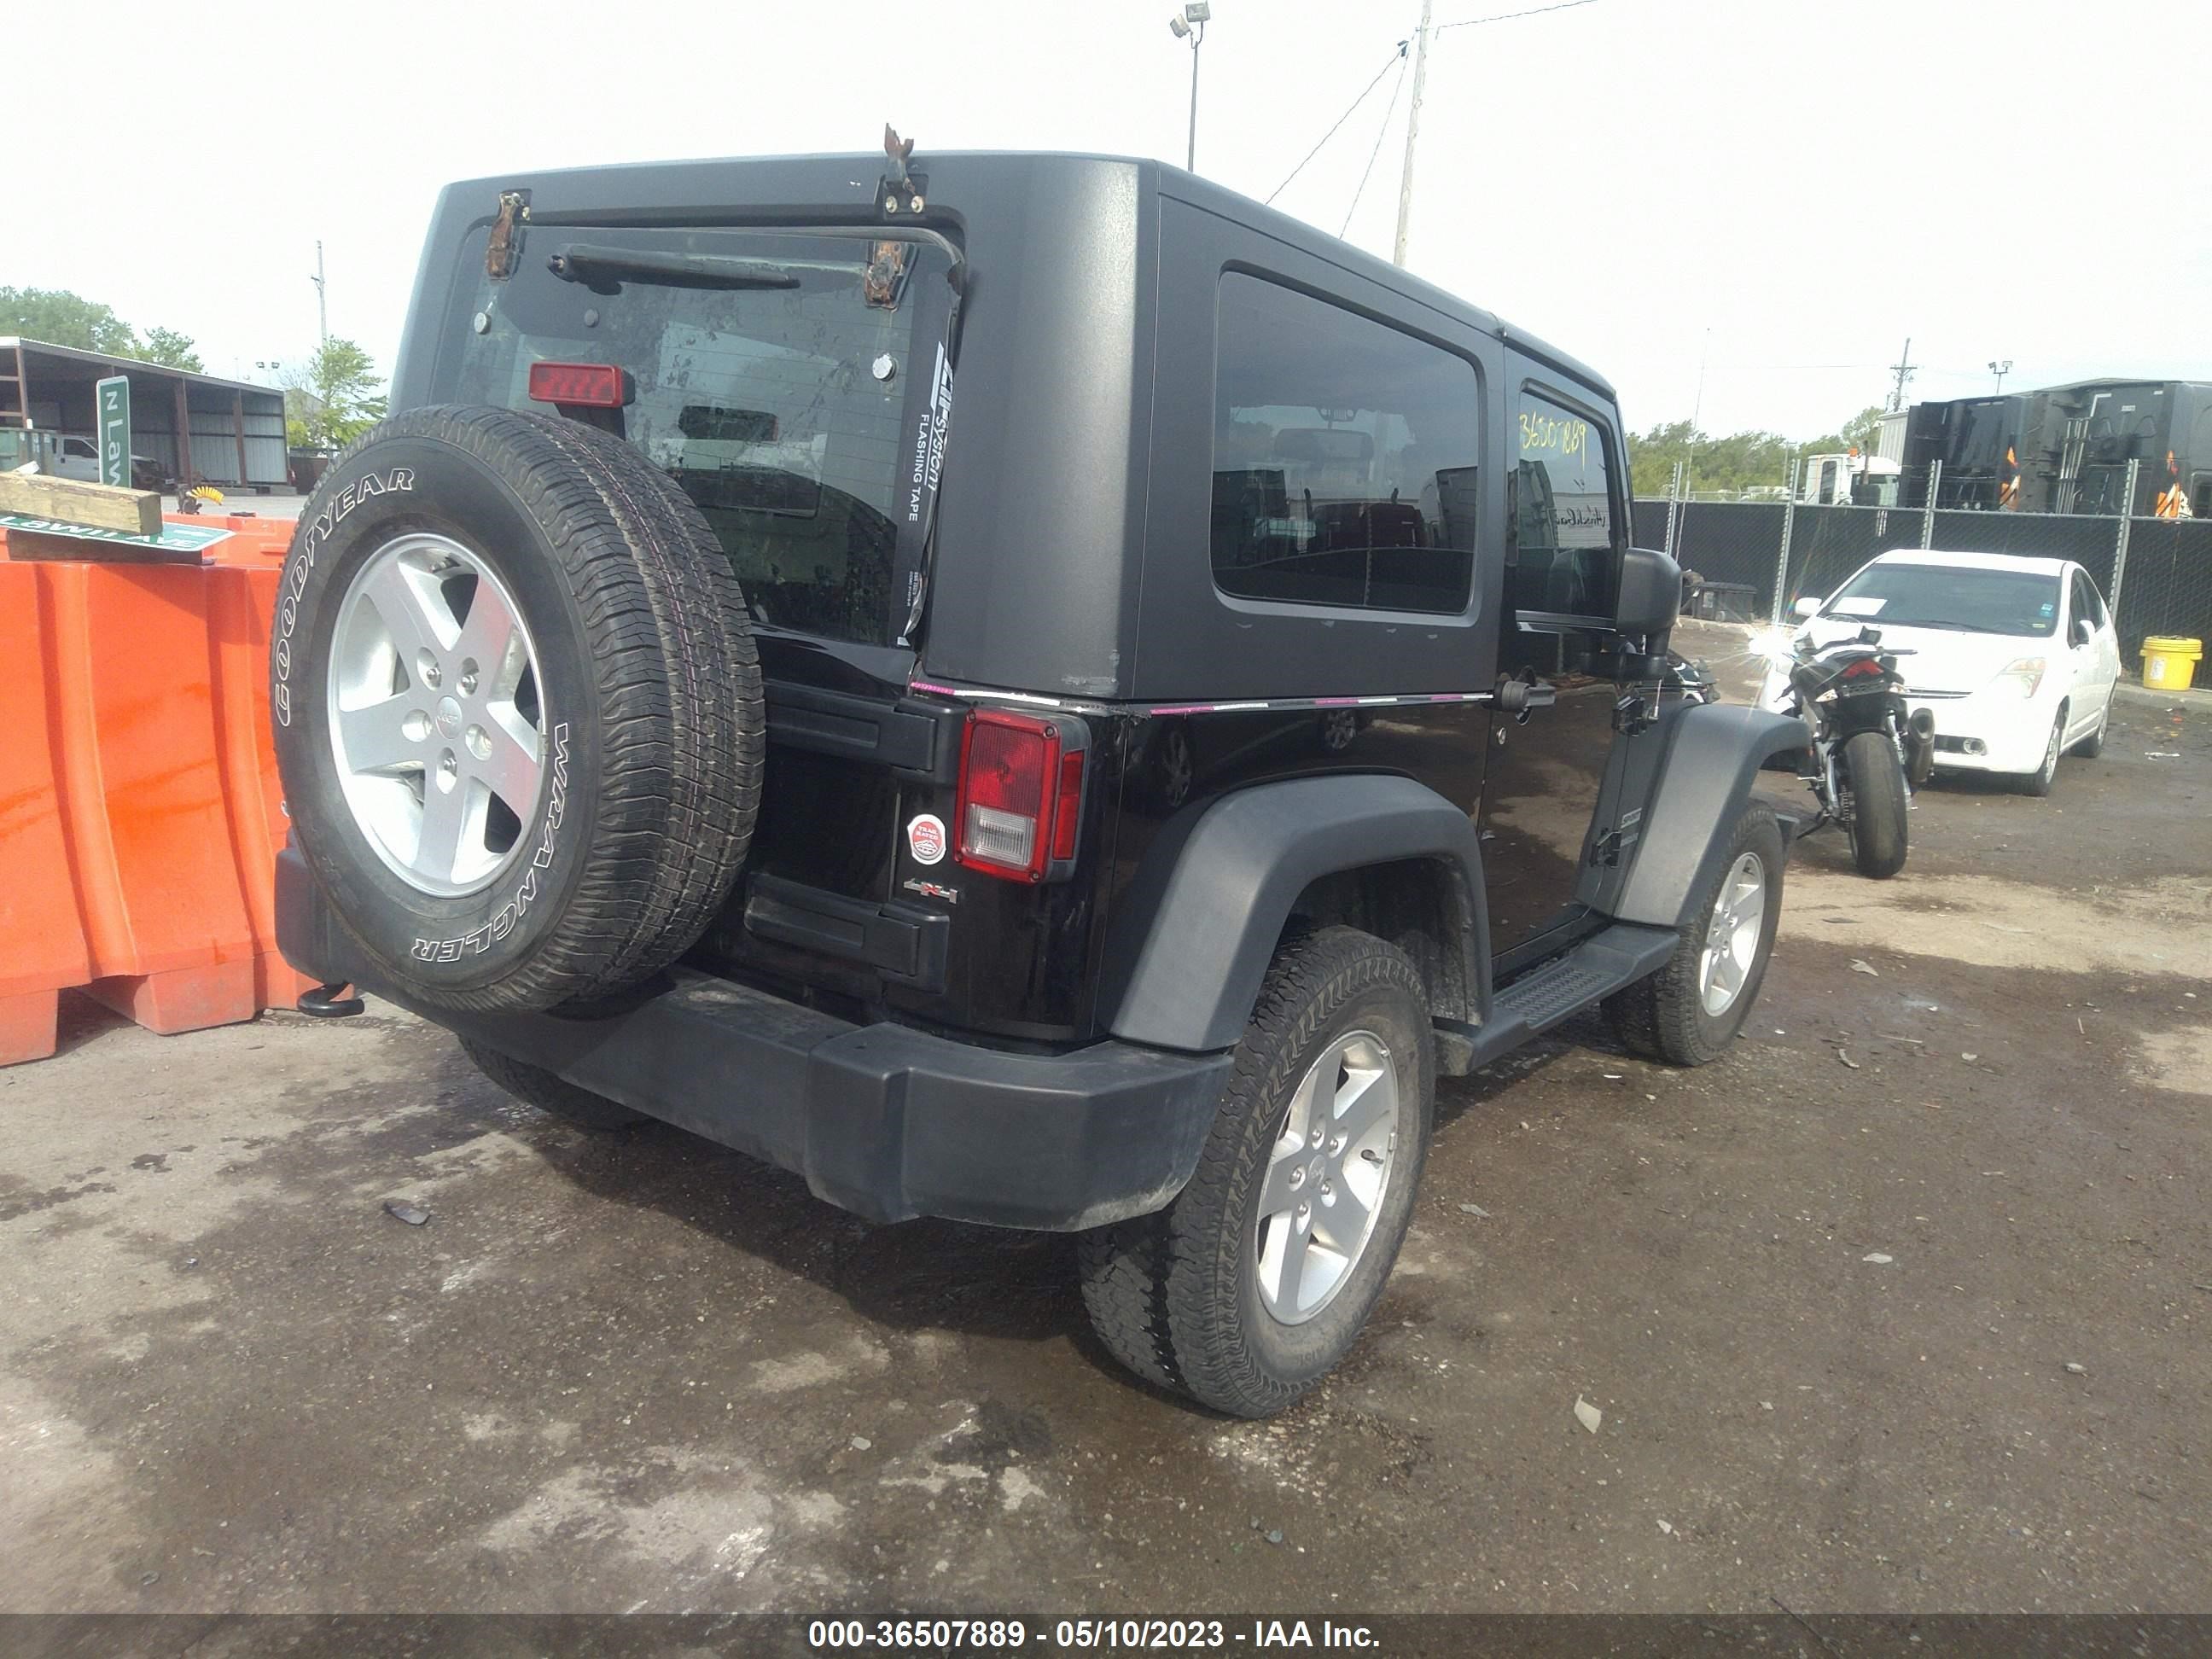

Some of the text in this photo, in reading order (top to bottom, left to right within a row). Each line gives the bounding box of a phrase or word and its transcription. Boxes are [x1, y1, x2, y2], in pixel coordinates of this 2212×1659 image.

[106, 391, 119, 410] N
[909, 414, 930, 521] FLASHING TAPE
[275, 468, 415, 727] GOODYEAR
[411, 722, 568, 963] WRANGLER
